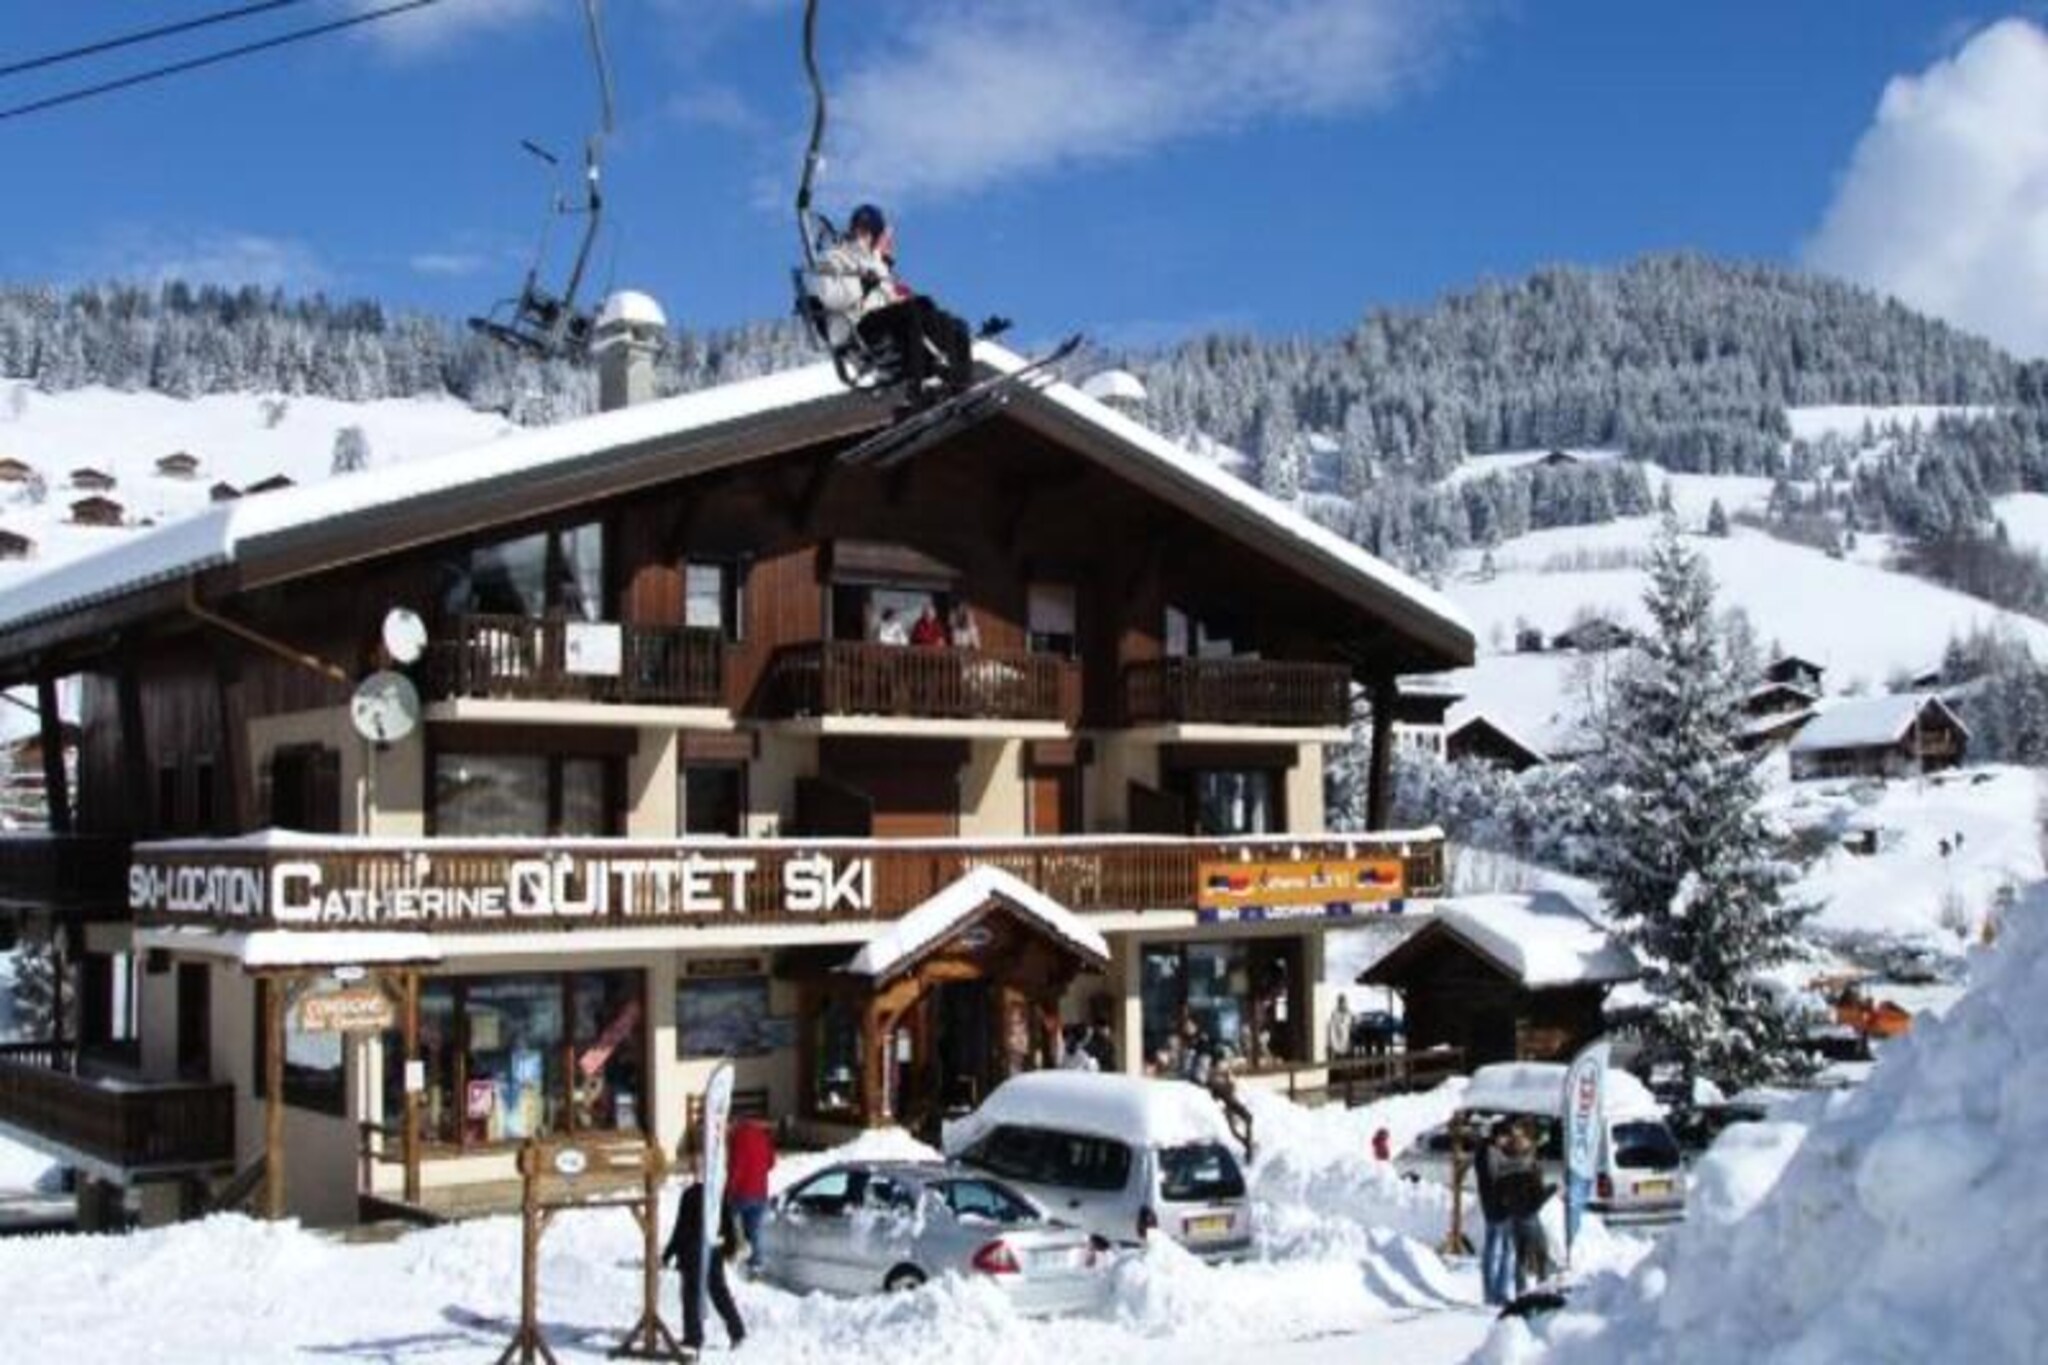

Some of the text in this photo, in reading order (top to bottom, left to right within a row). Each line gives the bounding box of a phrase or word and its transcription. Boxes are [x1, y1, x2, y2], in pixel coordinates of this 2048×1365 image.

[271, 857, 872, 922] CATHERINE QUITTET SKI
